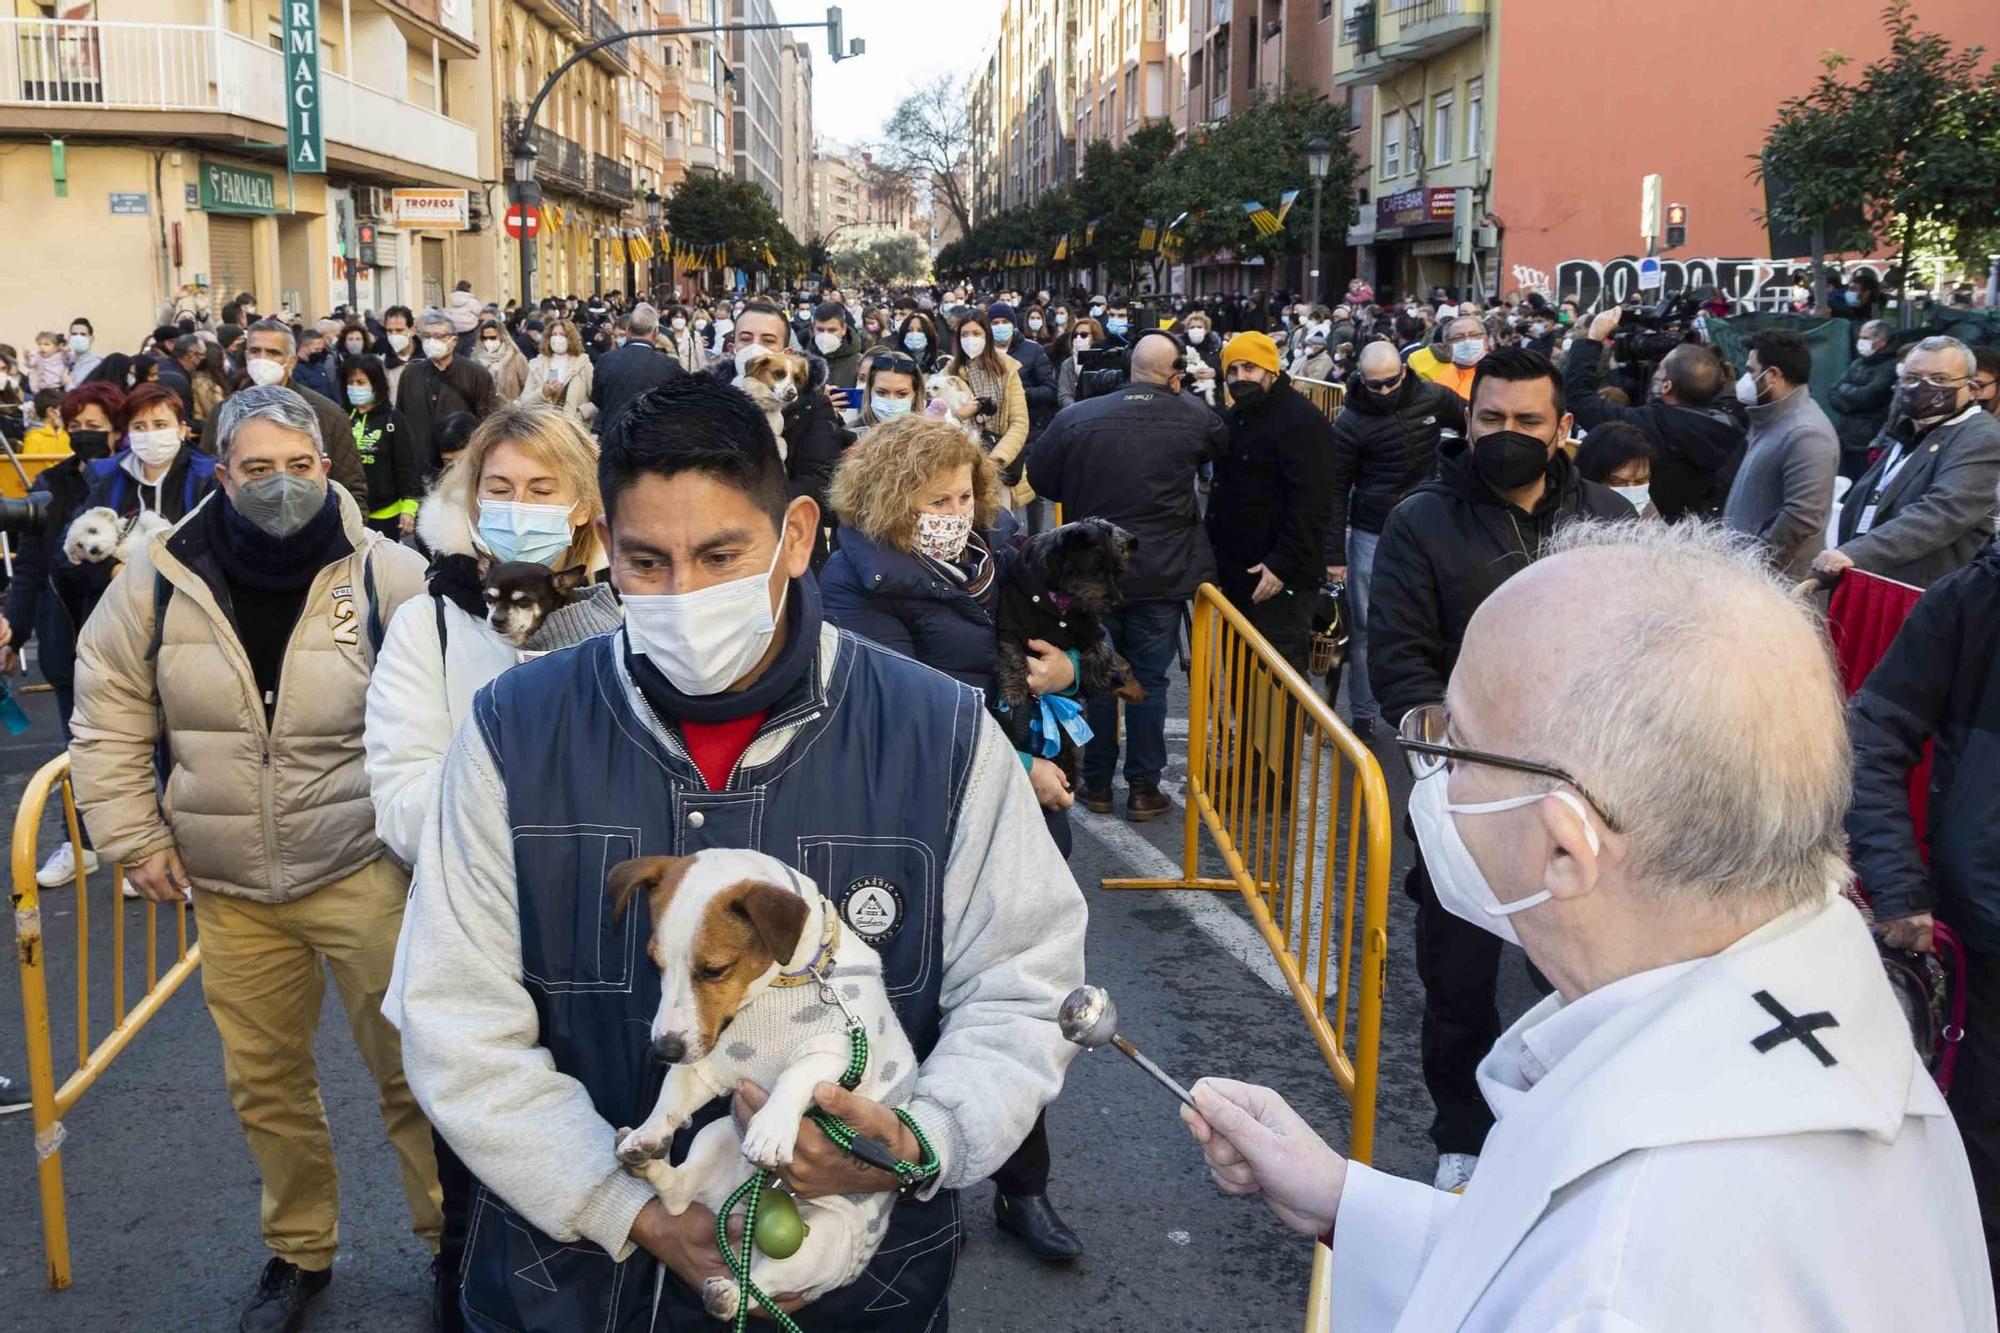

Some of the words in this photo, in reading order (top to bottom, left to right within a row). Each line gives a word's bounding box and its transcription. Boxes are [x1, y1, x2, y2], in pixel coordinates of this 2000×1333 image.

[290, 2, 316, 162] RMACIA
[221, 171, 274, 208] FARMACIA
[405, 198, 454, 208] TROFEOS
[851, 878, 895, 892] CLASSIC
